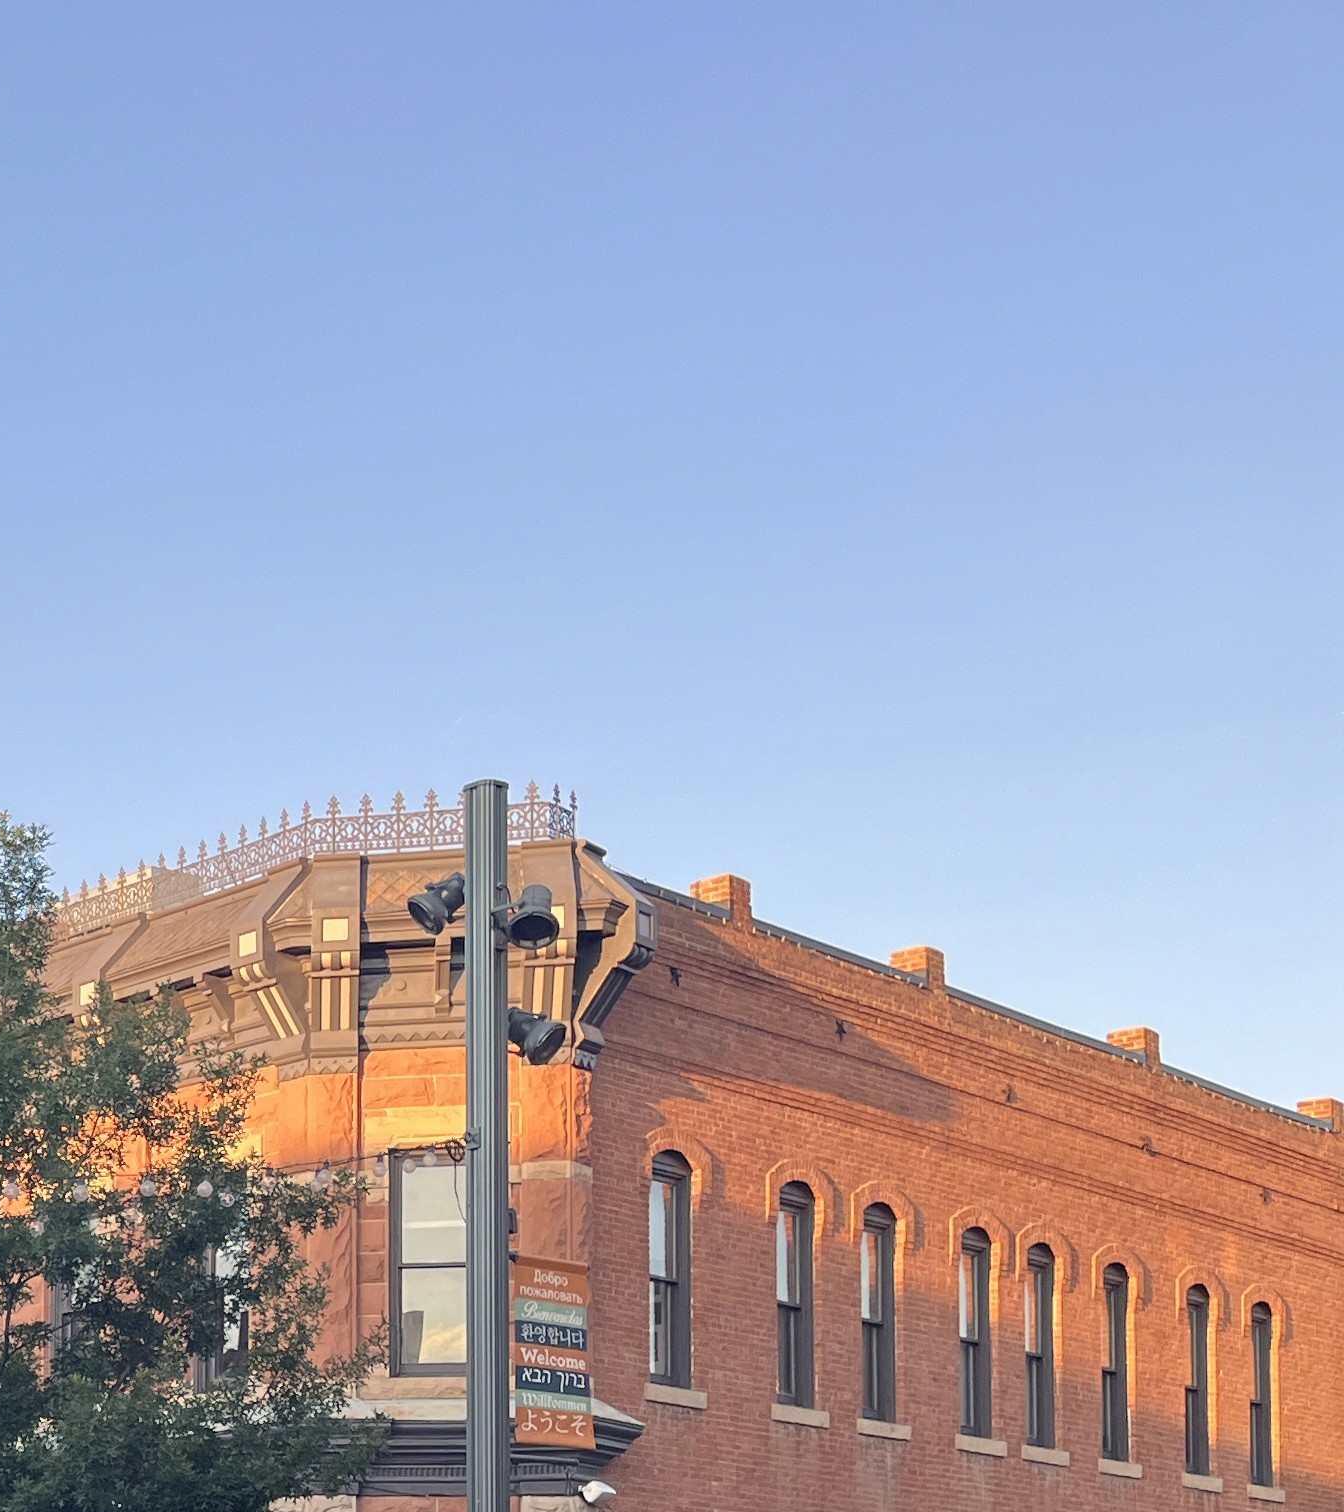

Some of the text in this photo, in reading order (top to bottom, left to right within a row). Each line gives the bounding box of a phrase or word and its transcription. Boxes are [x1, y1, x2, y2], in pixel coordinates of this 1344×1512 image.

[533, 1268, 569, 1288] Добро
[519, 1285, 583, 1304] пожаловать
[520, 1322, 585, 1349] 환영합니다
[520, 1347, 587, 1371] Welcome
[522, 1367, 586, 1393] ברוך הבא
[521, 1391, 587, 1412] Willkommen
[521, 1409, 587, 1437] ようこそ
